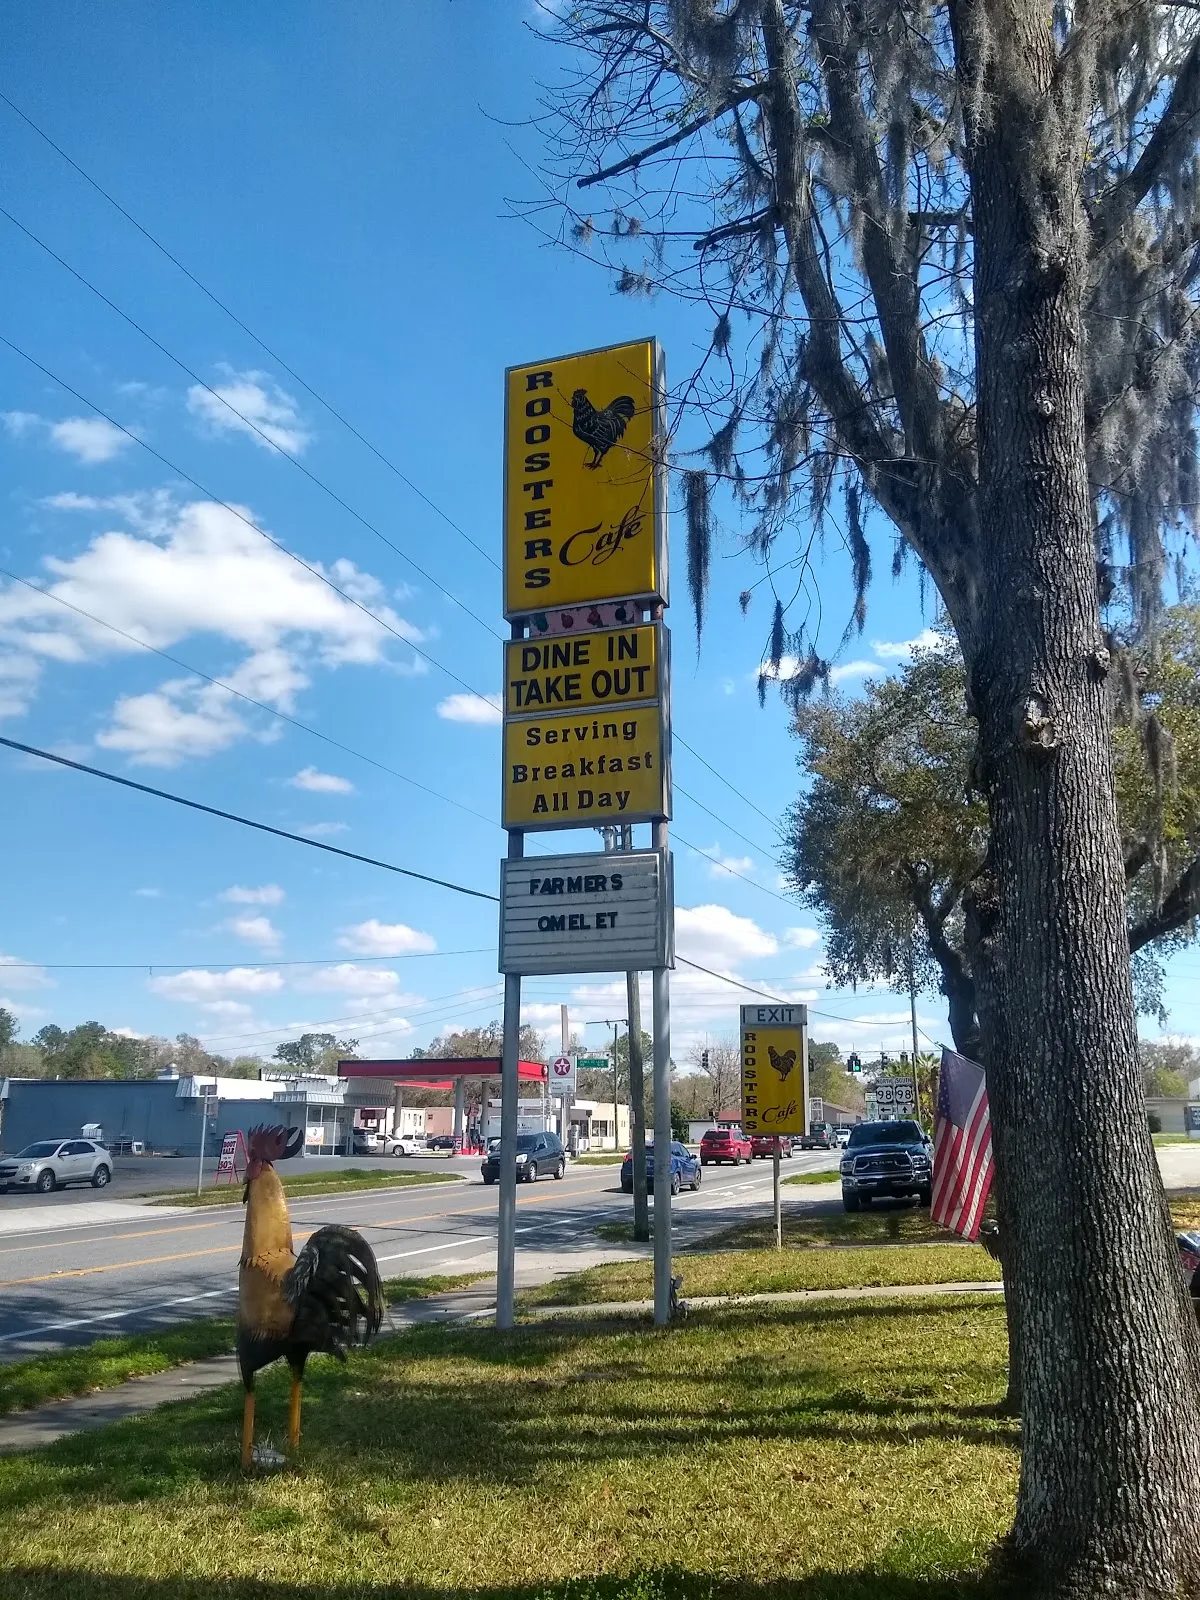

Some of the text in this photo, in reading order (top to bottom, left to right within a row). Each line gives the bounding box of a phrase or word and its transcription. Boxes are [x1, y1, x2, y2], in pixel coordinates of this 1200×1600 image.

[523, 371, 553, 589] ROOSTERS
[558, 505, 647, 566] Café
[522, 633, 638, 672] DINE IN
[511, 666, 650, 707] TAKE OUT
[526, 720, 637, 746] Serving
[512, 751, 653, 784] Breakfast
[533, 790, 630, 813] All Day
[529, 873, 623, 895] FARMERS
[757, 1008, 795, 1022] EXIT
[744, 1032, 758, 1130] ROOSTERS
[877, 1090, 892, 1100] 98
[895, 1090, 911, 1099] 98
[761, 1100, 799, 1124] Café
